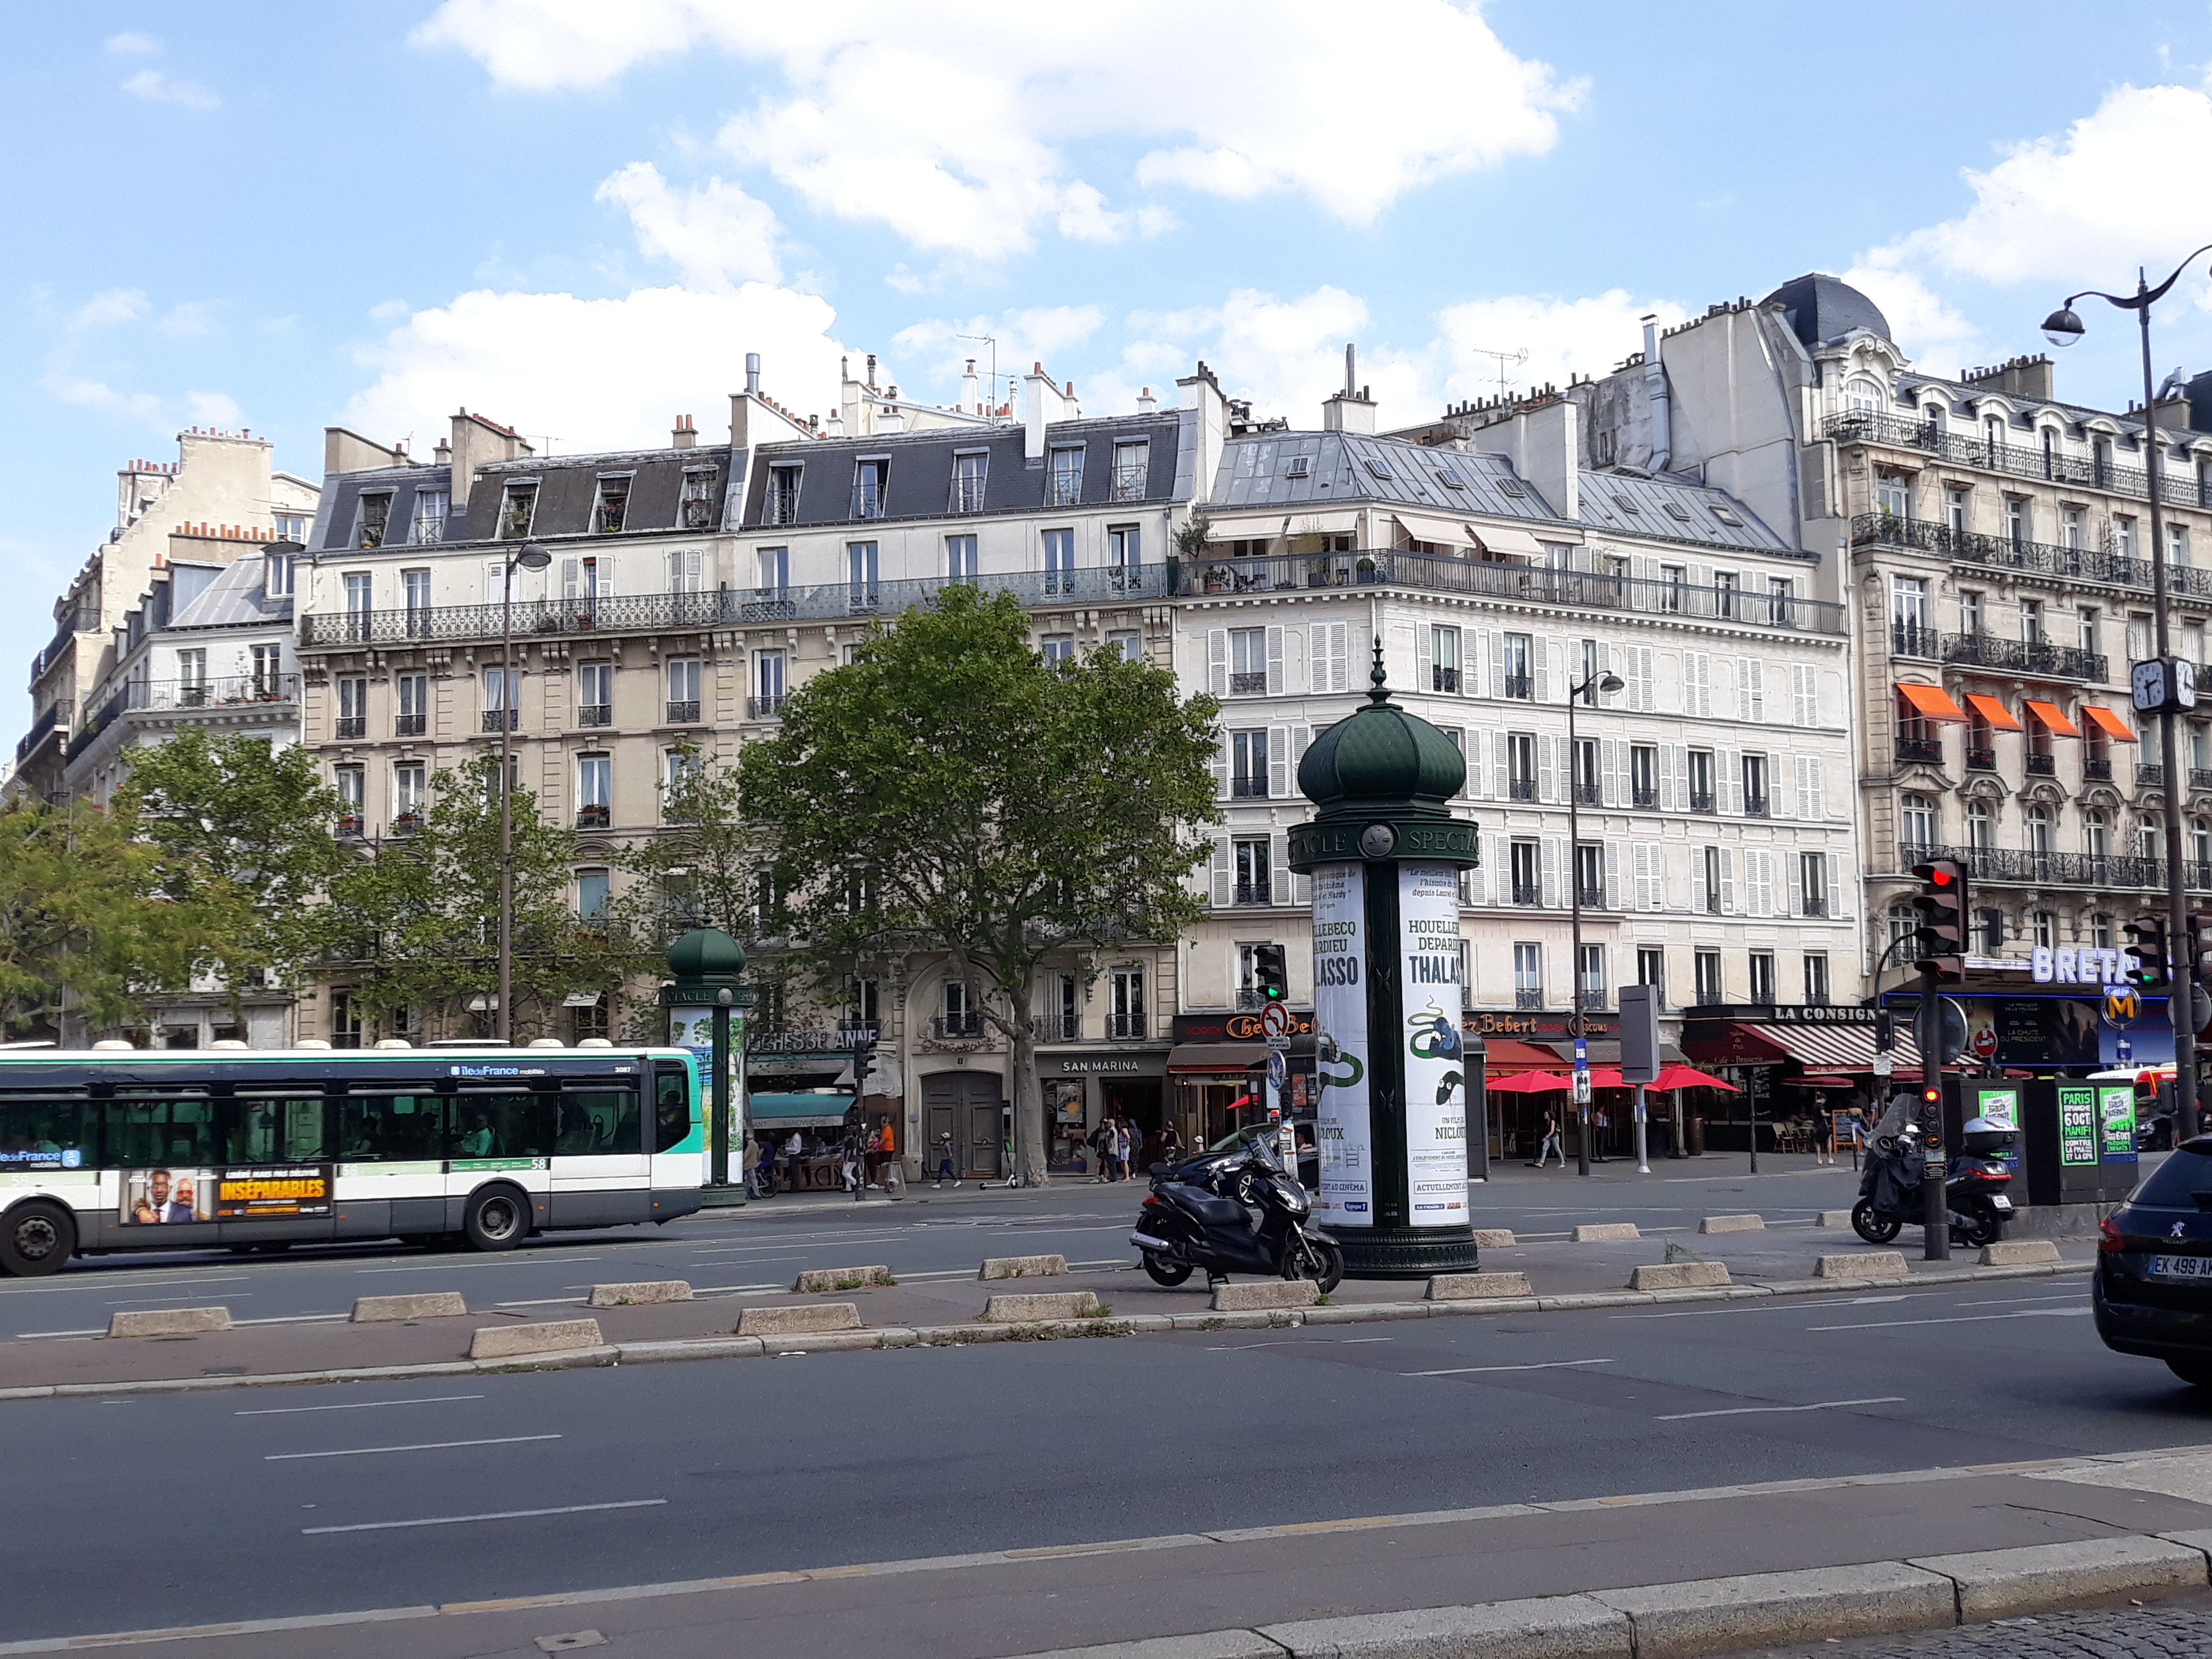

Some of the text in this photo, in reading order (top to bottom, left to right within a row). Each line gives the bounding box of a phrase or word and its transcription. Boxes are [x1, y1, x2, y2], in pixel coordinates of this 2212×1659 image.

[1317, 956, 1358, 987] ASSO
[2031, 945, 2173, 985] BRETA
[1774, 1007, 1887, 1021] LA CONSIGN
[2108, 994, 2134, 1019] M
[1226, 1015, 1263, 1038] Che
[1480, 1013, 1537, 1034] Bebert
[1063, 1061, 1139, 1071] SAN MARINA
[2063, 1093, 2091, 1104] PARIS
[531, 1158, 547, 1170] 58
